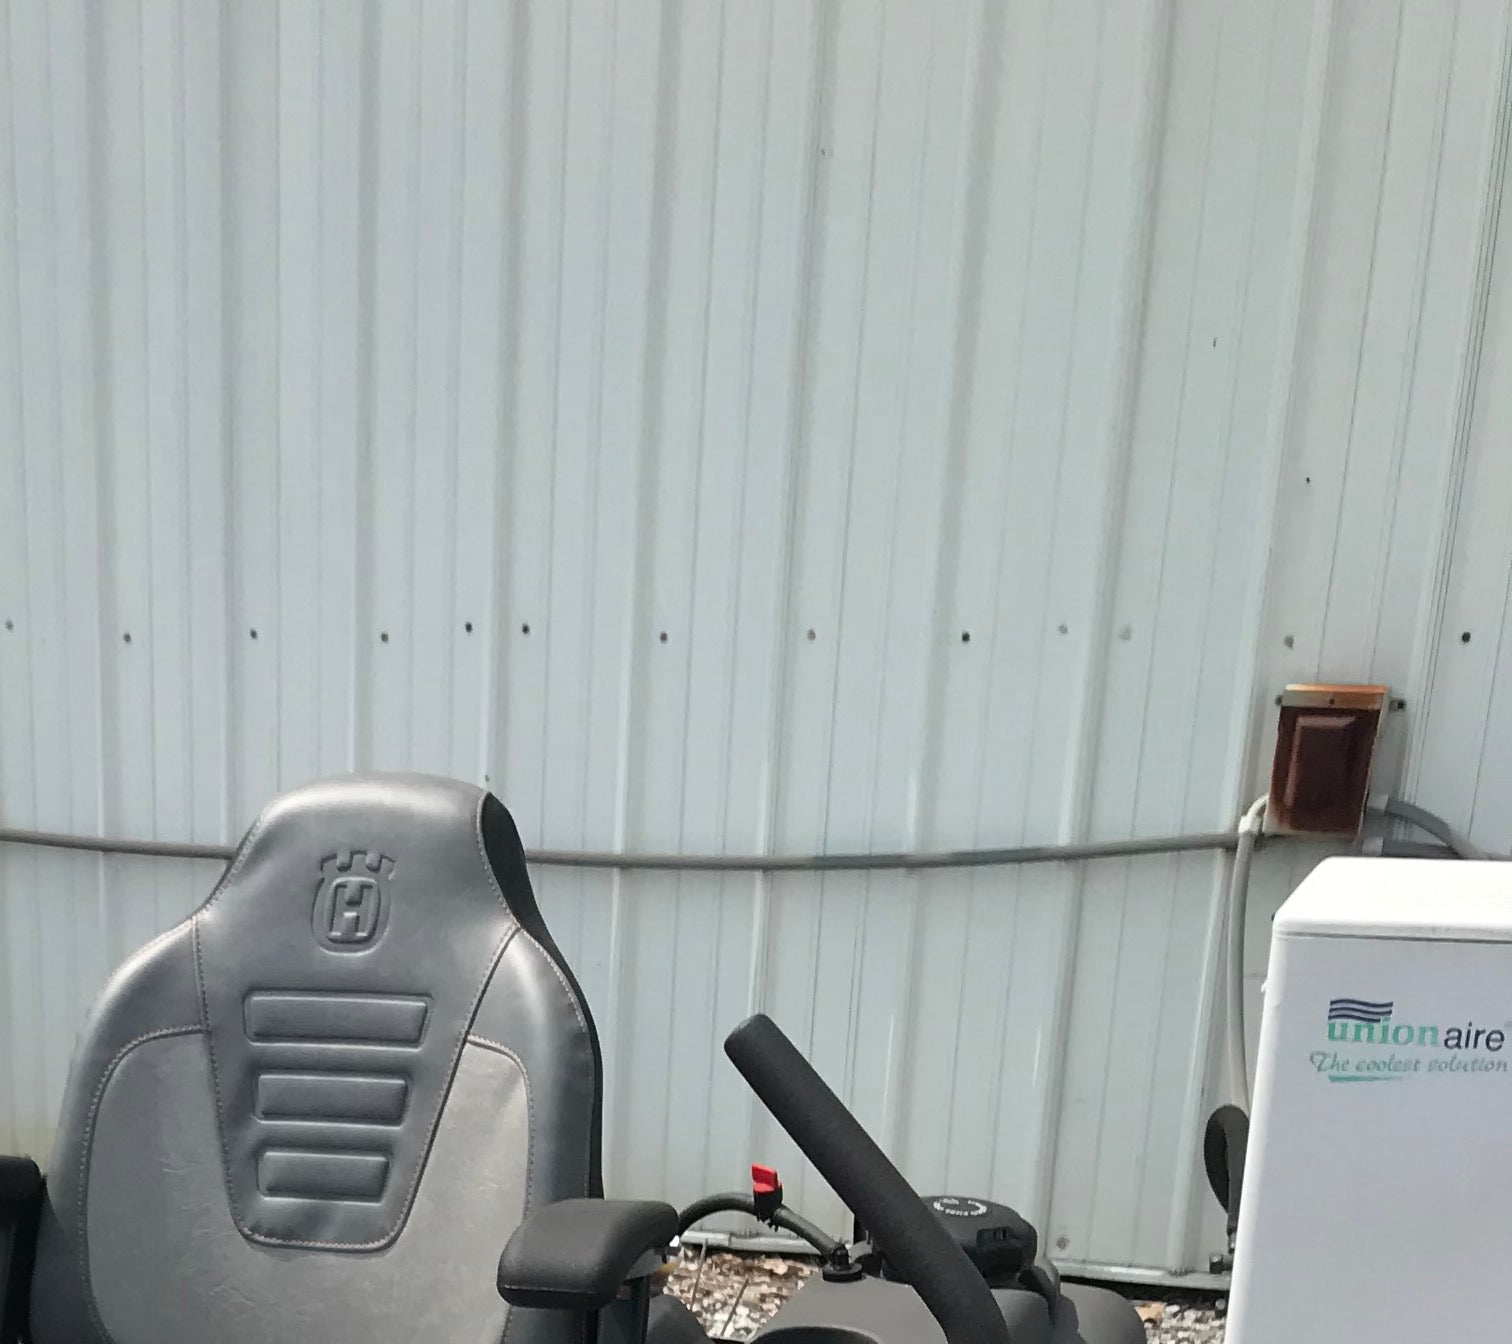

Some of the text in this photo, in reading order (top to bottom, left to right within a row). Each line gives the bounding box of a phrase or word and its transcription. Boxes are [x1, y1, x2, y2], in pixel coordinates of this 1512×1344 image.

[1310, 1051, 1508, 1073] The coolest solution
